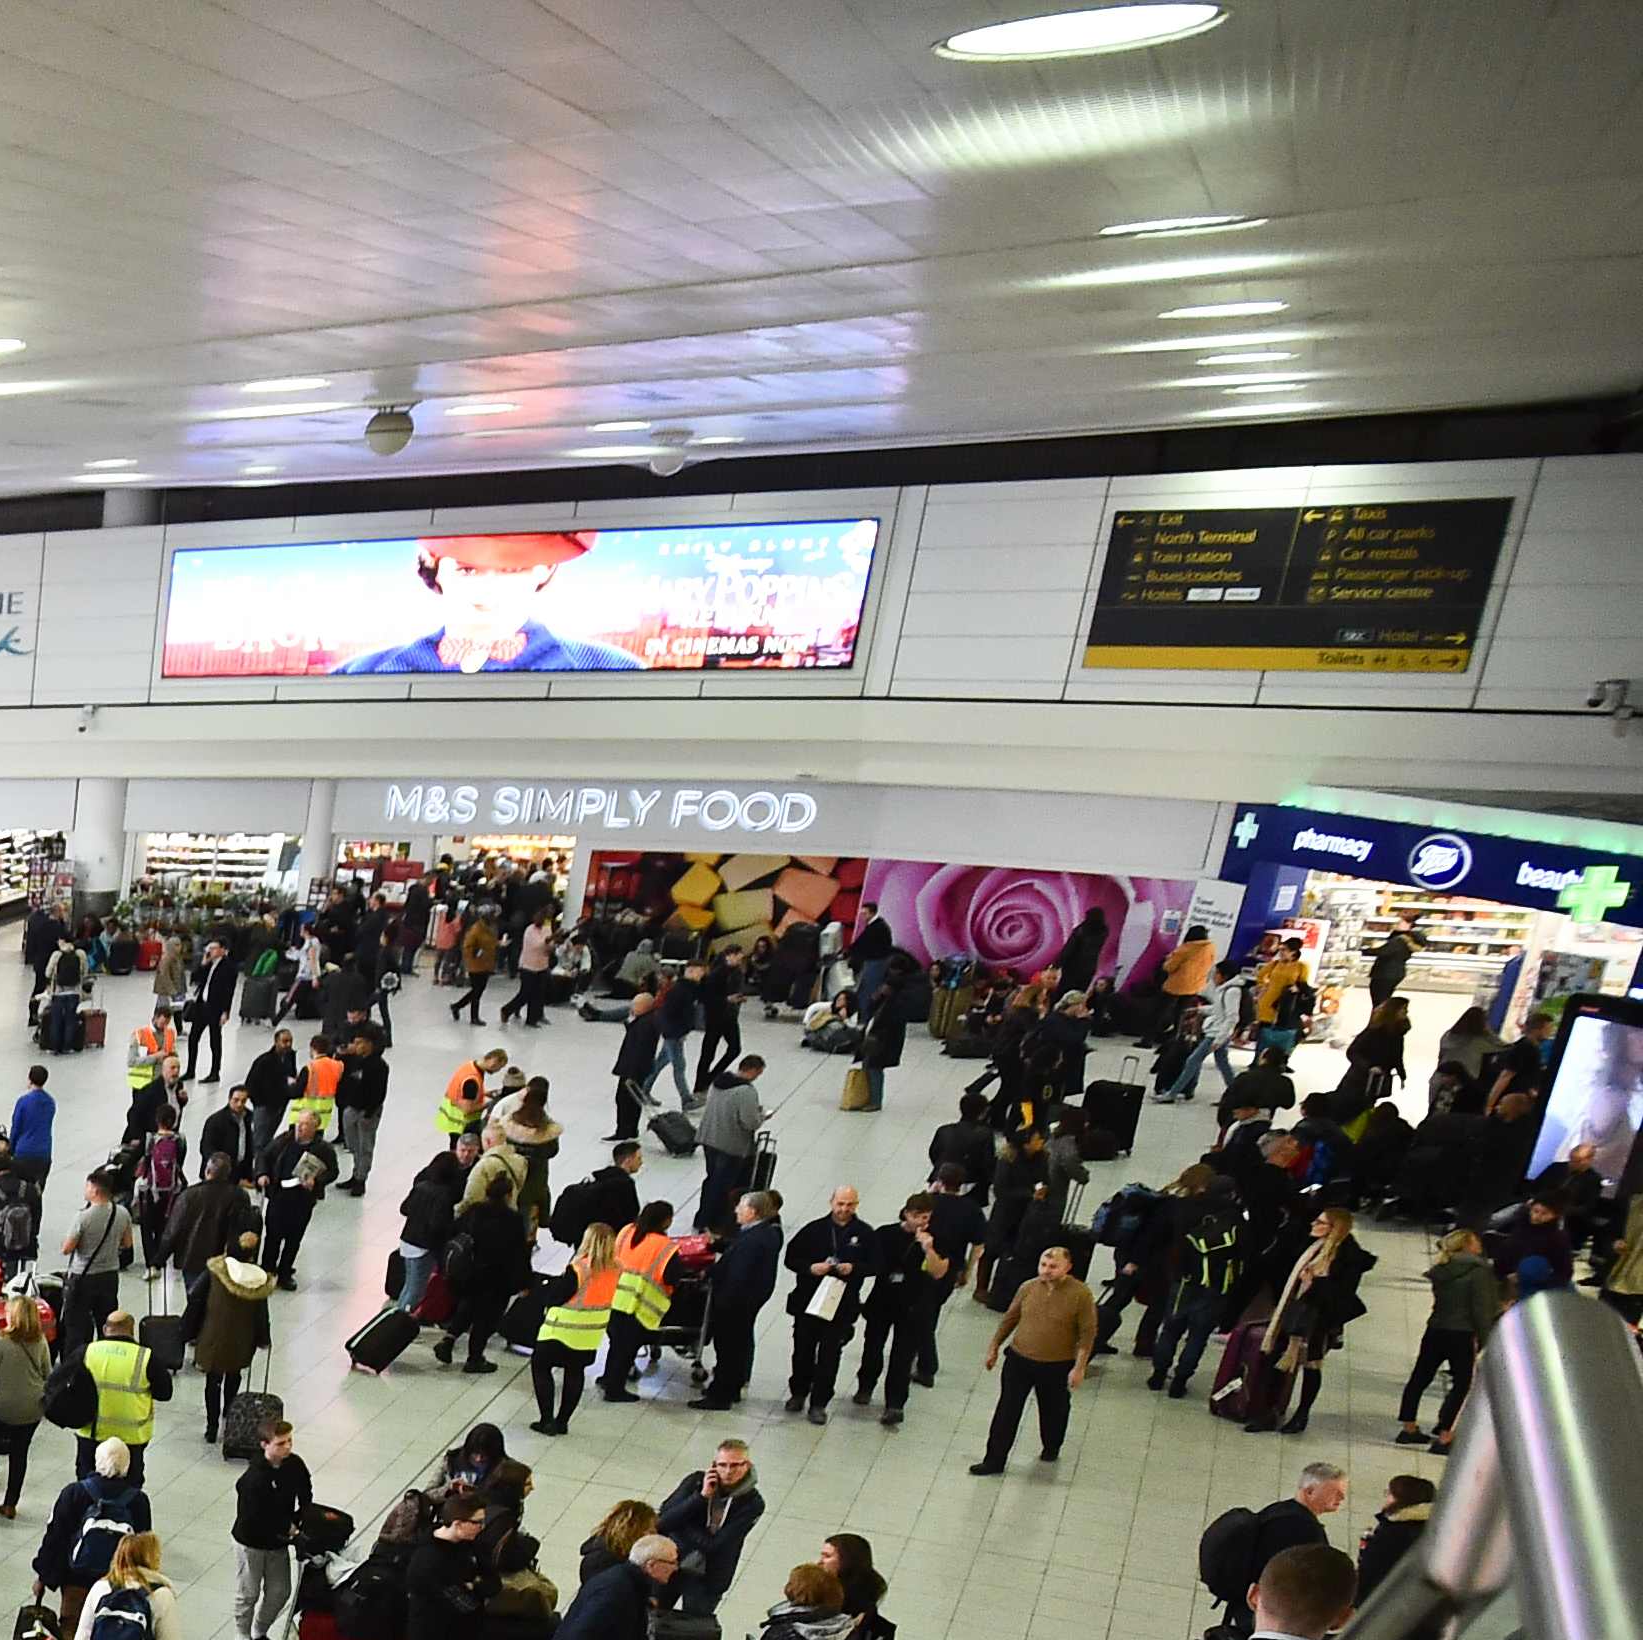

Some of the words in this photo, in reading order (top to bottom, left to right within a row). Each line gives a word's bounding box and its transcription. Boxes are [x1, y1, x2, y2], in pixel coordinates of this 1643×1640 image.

[1158, 513, 1184, 526] Exit
[1353, 507, 1388, 520] Taxis
[1154, 531, 1195, 545] North
[1198, 528, 1258, 545] Terminal
[1344, 527, 1364, 541] All
[1367, 529, 1391, 541] car
[1393, 527, 1436, 543] parks
[1152, 551, 1183, 563] Train
[1185, 551, 1233, 563] station
[1339, 547, 1365, 561] Car
[1335, 568, 1412, 583] Passenger
[1329, 586, 1383, 600] Service
[1385, 587, 1435, 600] centre
[671, 635, 760, 656] CINEMAS
[762, 635, 810, 655] NOW
[1317, 651, 1365, 665] Toilets
[387, 784, 479, 824] M&S
[492, 785, 662, 829] SIMPLY
[670, 789, 817, 833] FOOD
[1292, 827, 1373, 863] pharmacy
